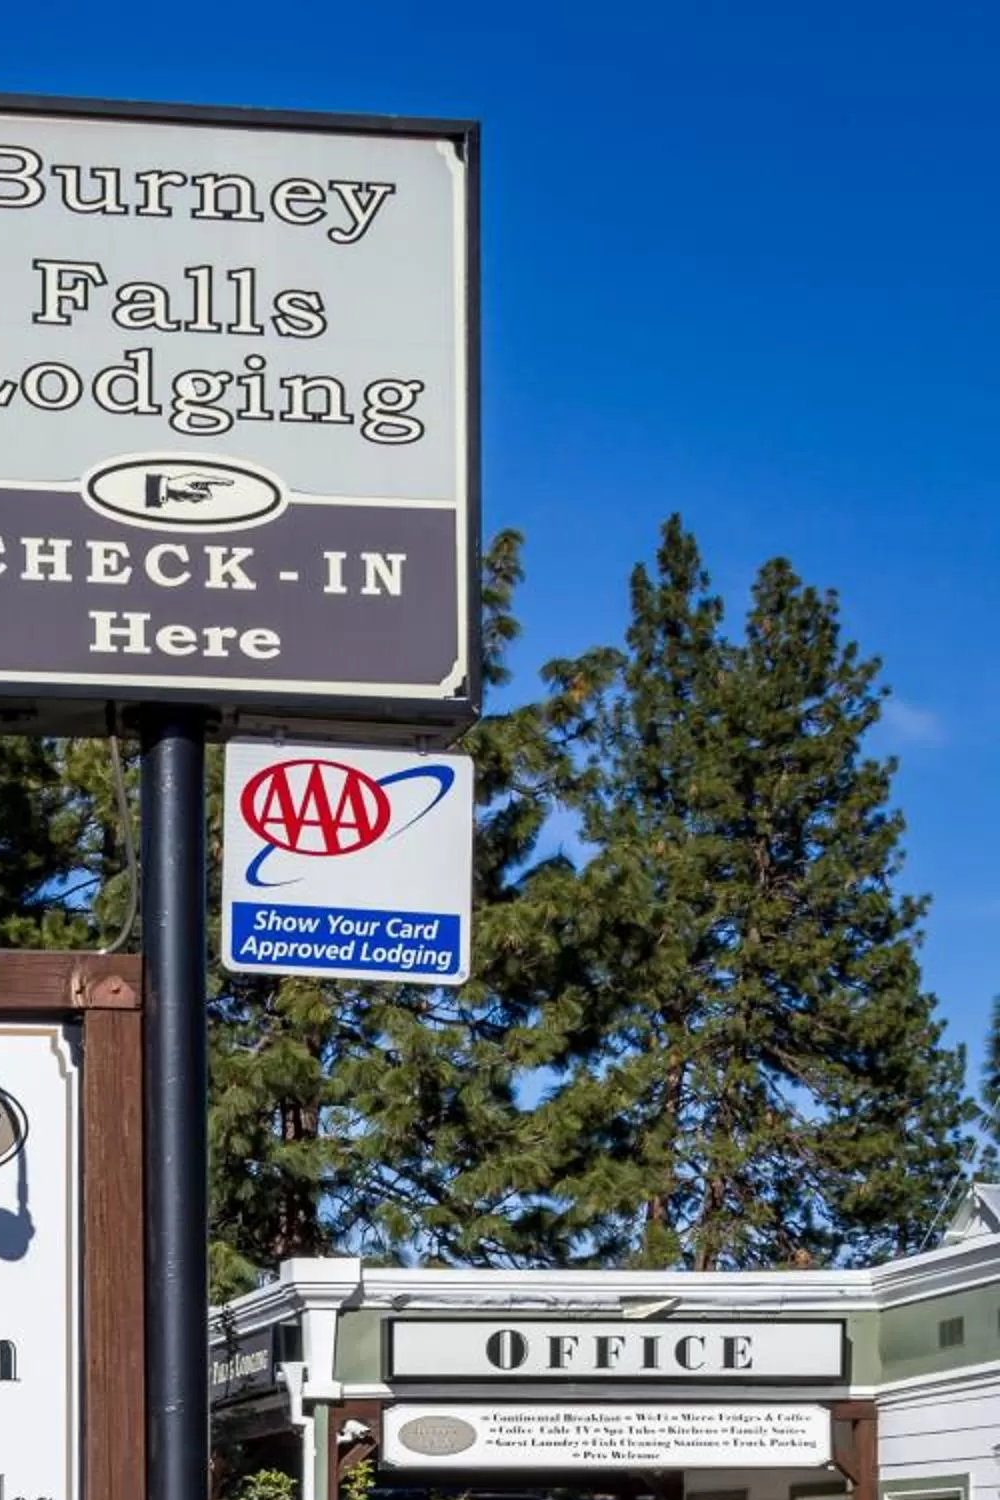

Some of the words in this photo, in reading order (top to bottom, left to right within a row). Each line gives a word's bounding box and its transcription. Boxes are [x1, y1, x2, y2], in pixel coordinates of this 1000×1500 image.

[32, 258, 327, 338] Falls
[89, 610, 281, 659] Here
[257, 762, 378, 854] AAA
[253, 910, 319, 933] Show
[327, 914, 380, 937] Your
[386, 918, 439, 940] Card
[240, 935, 355, 961] Approved
[360, 941, 452, 971] Lodging
[485, 1329, 753, 1370] OFFICE
[493, 1413, 560, 1422] Continental
[563, 1413, 621, 1422] Breakfast
[719, 1412, 761, 1423] Fridges
[576, 1426, 590, 1434] TV
[628, 1426, 656, 1434] Tubs
[668, 1426, 719, 1434] Kitchens
[772, 1426, 807, 1434] Suites
[531, 1439, 579, 1448] Laundry
[619, 1439, 671, 1448] Cleaning
[673, 1439, 719, 1447] Stations
[769, 1439, 817, 1448] Parking
[611, 1451, 660, 1459] Welcome
